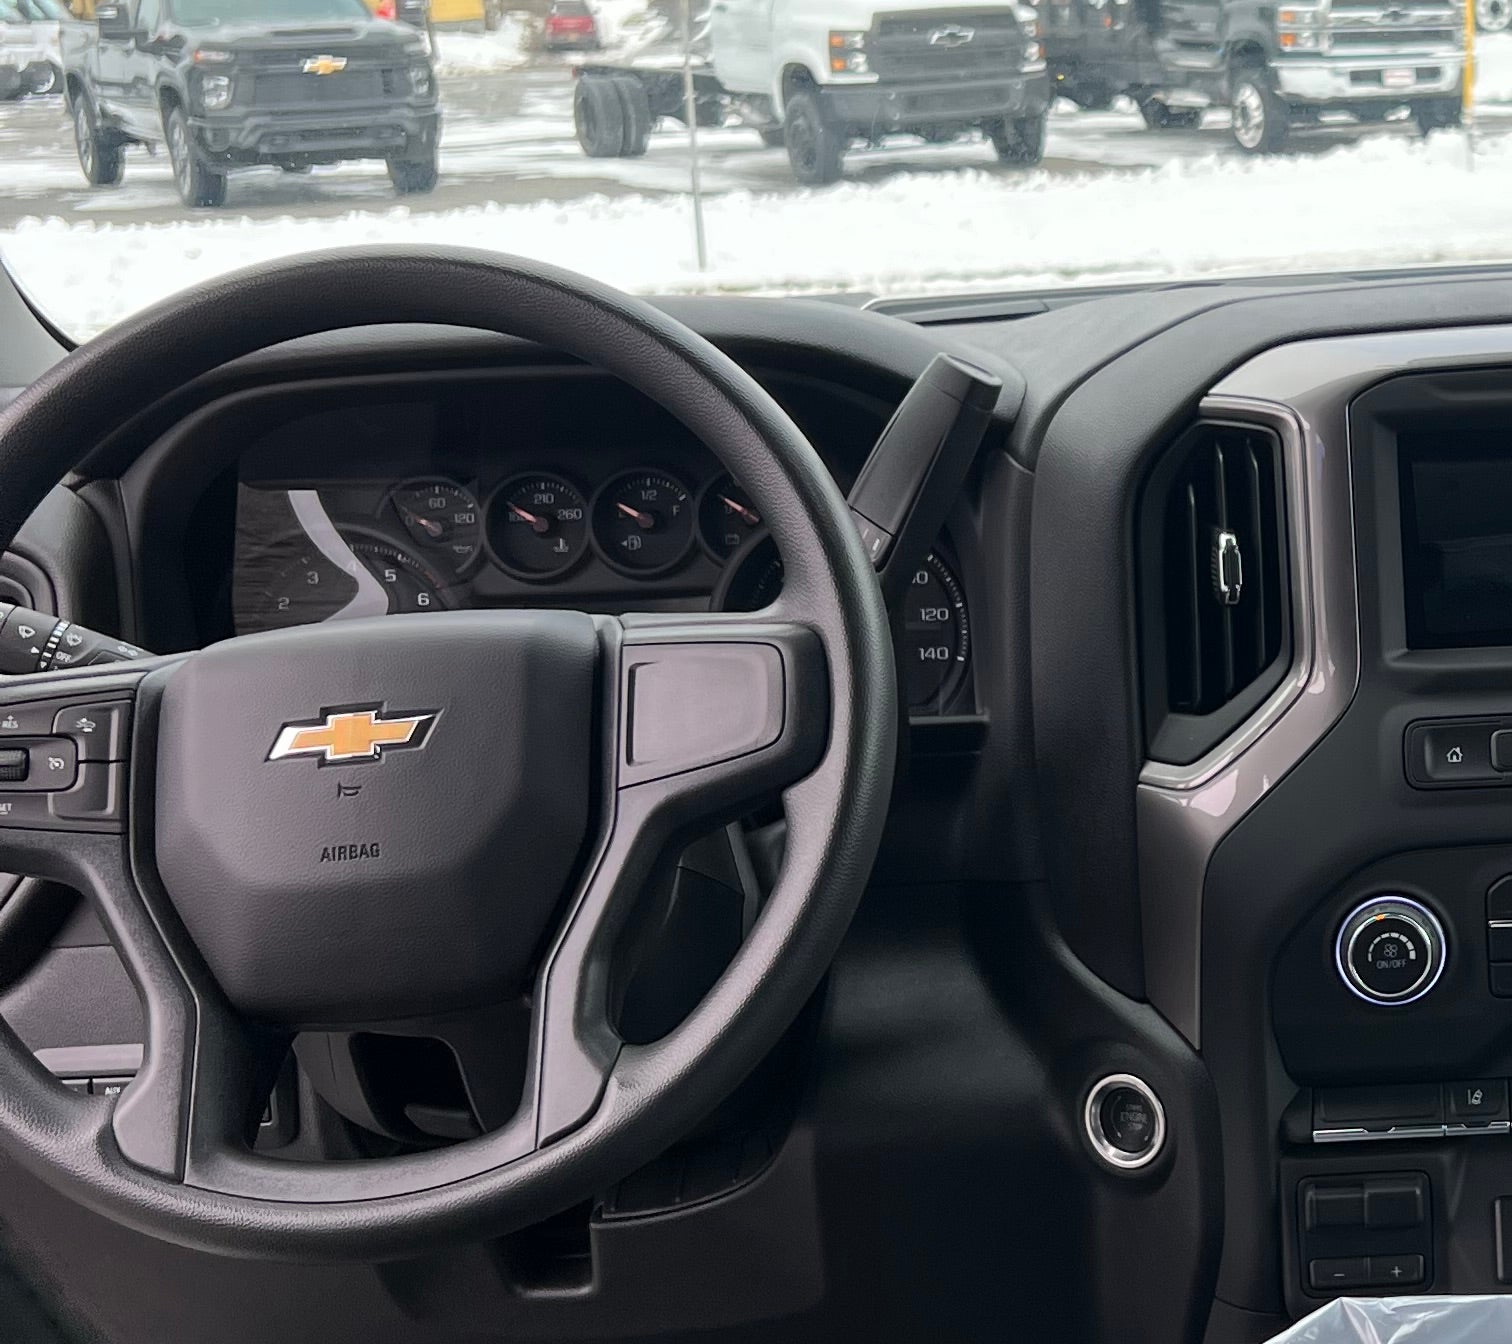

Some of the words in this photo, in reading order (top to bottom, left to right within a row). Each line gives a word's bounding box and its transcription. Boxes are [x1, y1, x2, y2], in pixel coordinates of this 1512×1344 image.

[428, 497, 446, 509] 60
[534, 493, 555, 505] 210
[557, 509, 583, 521] 260
[672, 505, 681, 516] F
[454, 512, 475, 524] 120
[307, 571, 319, 585] 3
[385, 569, 397, 583] 5
[278, 597, 290, 610] 2
[417, 592, 430, 606] 6
[920, 607, 949, 622] 120
[918, 647, 949, 660] 140
[320, 843, 380, 863] AIRBAG
[1376, 960, 1407, 970] ON/OFF
